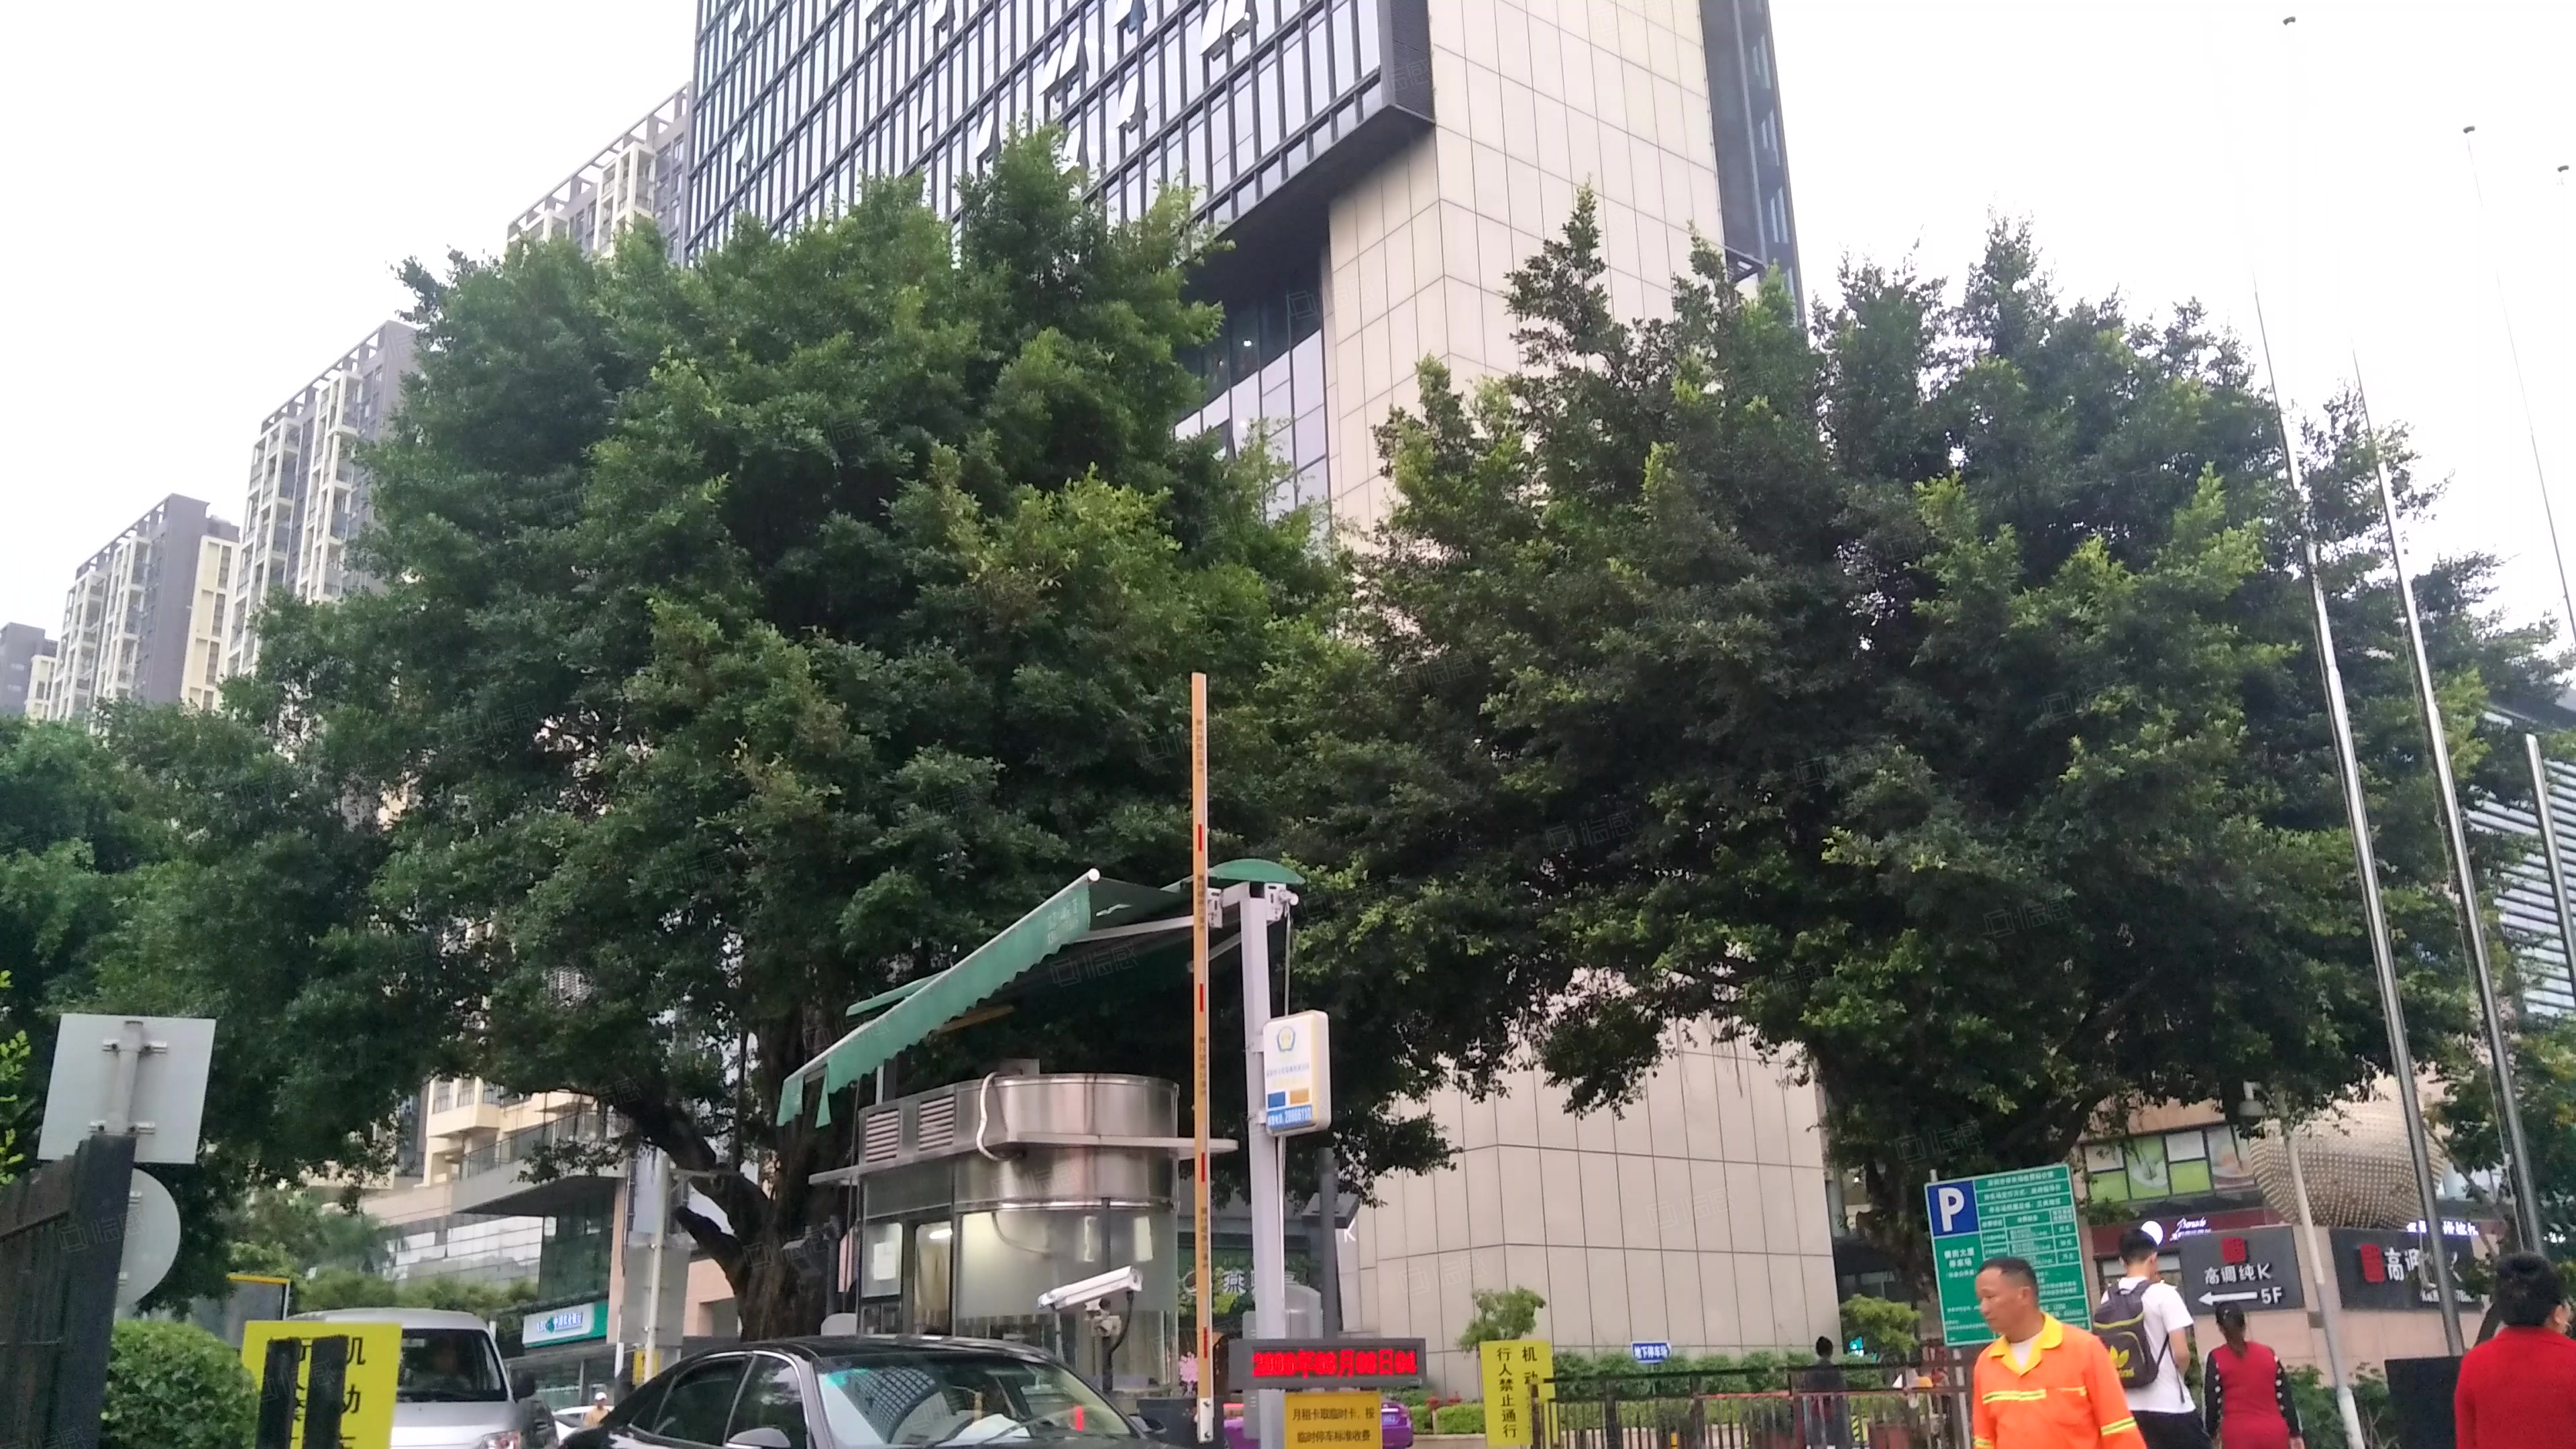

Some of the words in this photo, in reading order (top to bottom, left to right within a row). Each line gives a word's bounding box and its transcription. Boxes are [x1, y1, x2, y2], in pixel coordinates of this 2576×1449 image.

[1938, 1187, 1965, 1232] P
[2204, 1263, 2272, 1285] 高调纯K
[2261, 1286, 2282, 1304] 5F
[1497, 1347, 1518, 1438] 行人禁止通行
